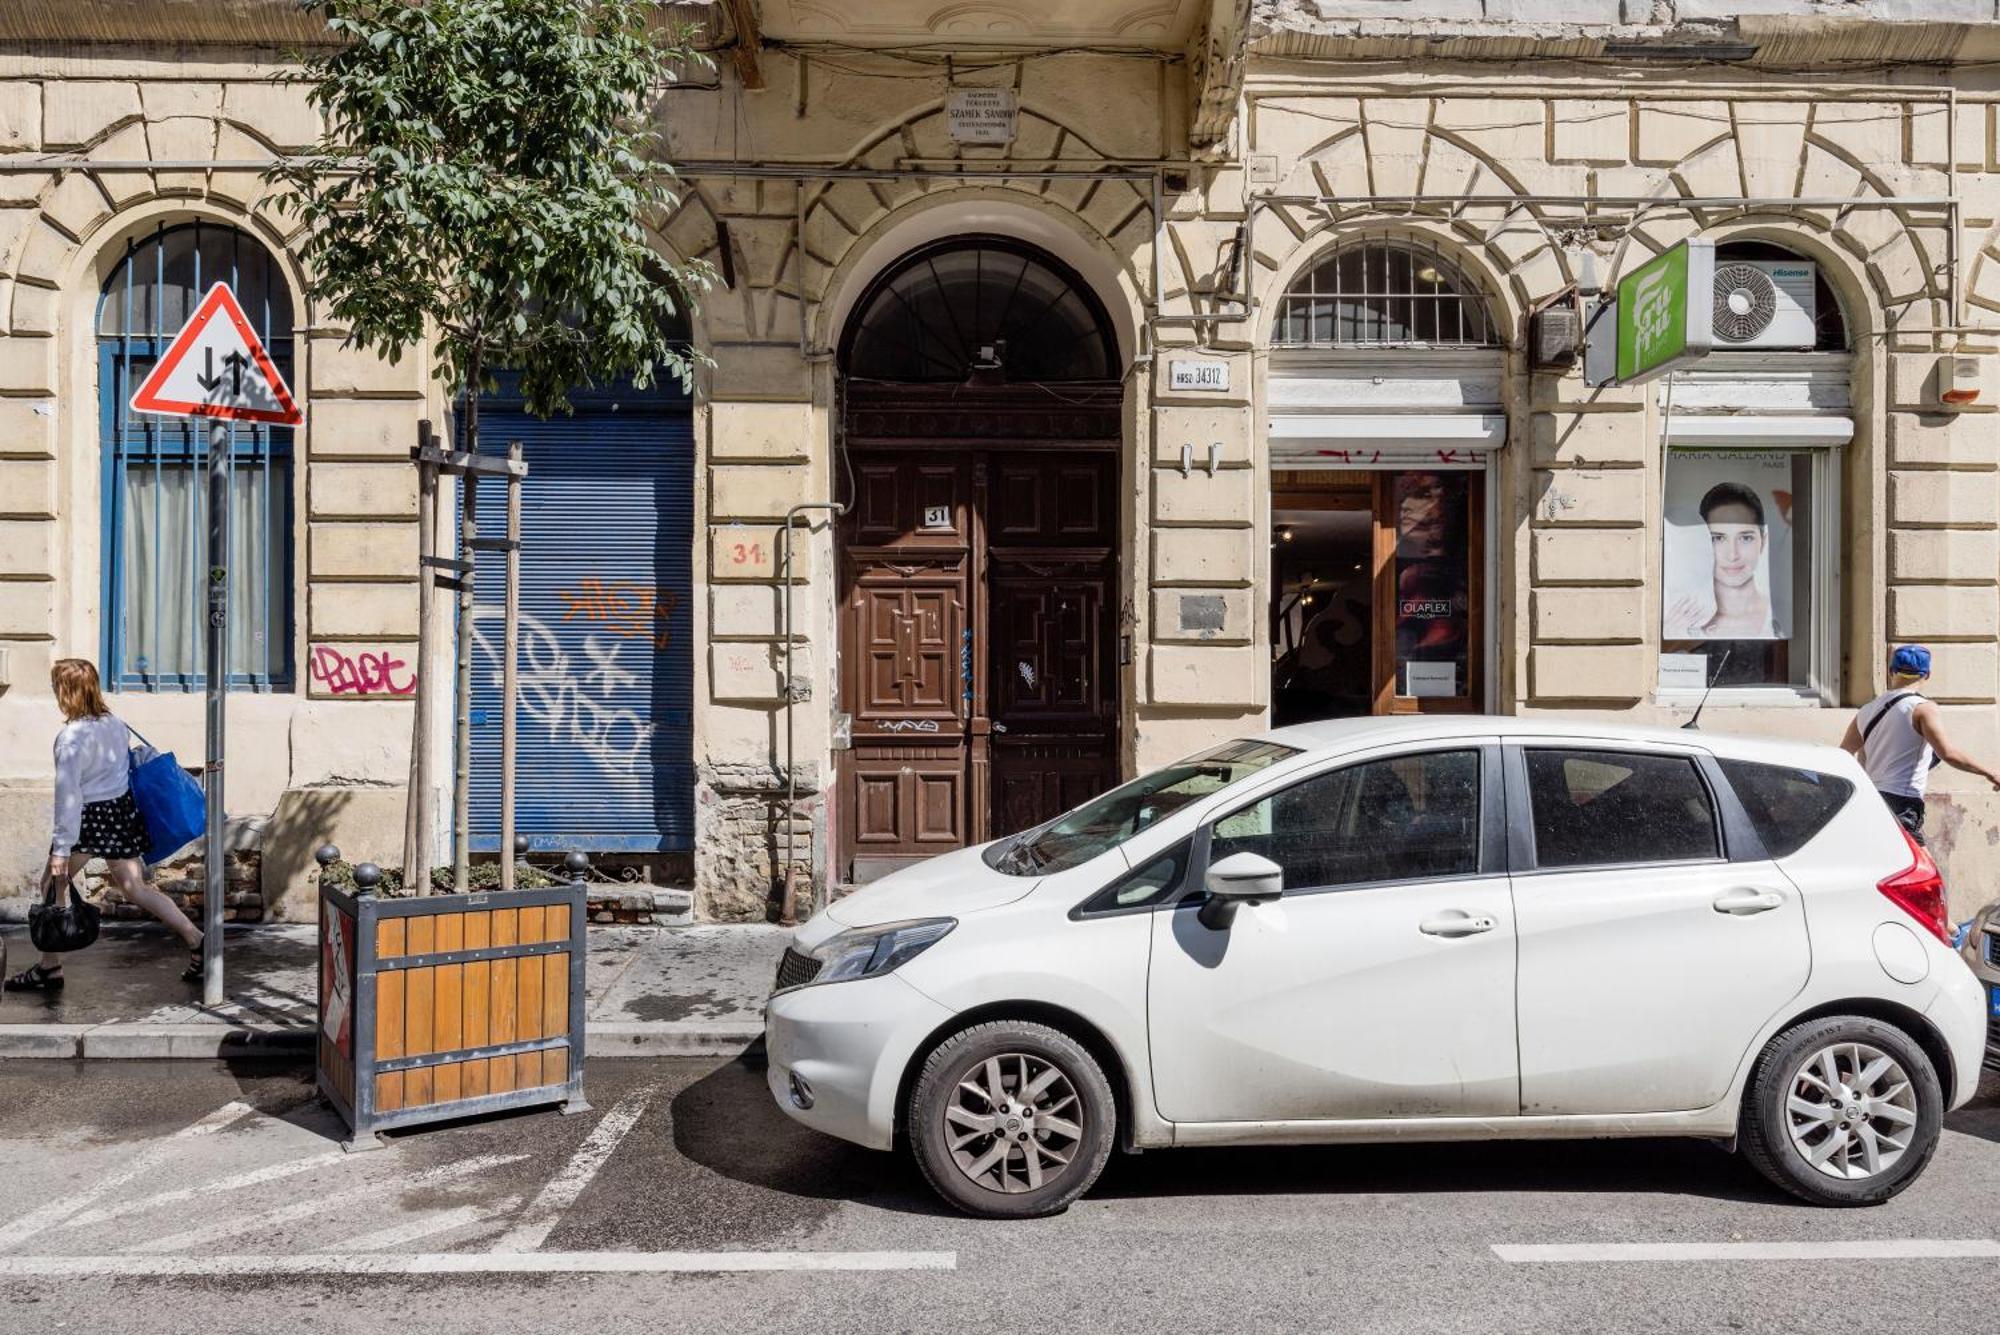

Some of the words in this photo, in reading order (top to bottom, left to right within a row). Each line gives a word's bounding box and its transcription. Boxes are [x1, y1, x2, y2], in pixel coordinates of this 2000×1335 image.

[1772, 268, 1809, 277] Hisense
[1195, 367, 1221, 385] 34312
[928, 508, 946, 523] 31
